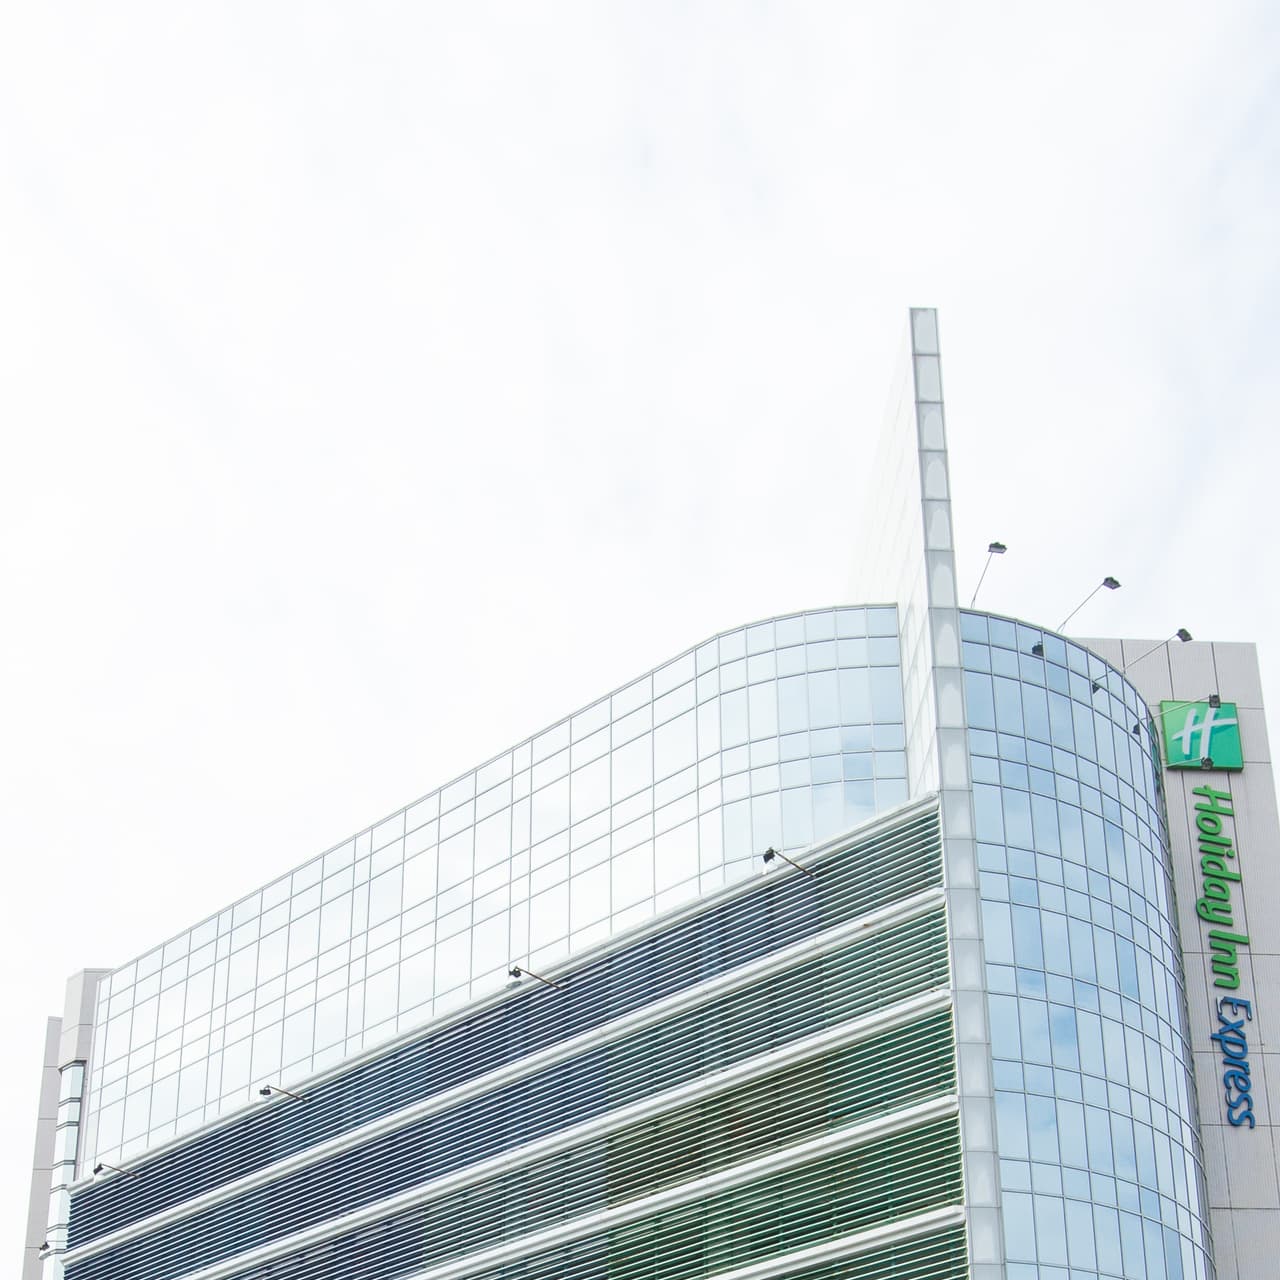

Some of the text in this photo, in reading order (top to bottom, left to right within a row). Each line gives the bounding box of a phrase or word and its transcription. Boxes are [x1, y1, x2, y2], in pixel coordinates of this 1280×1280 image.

[1193, 784, 1250, 990] Holiday Inn
[1210, 995, 1256, 1130] Express
